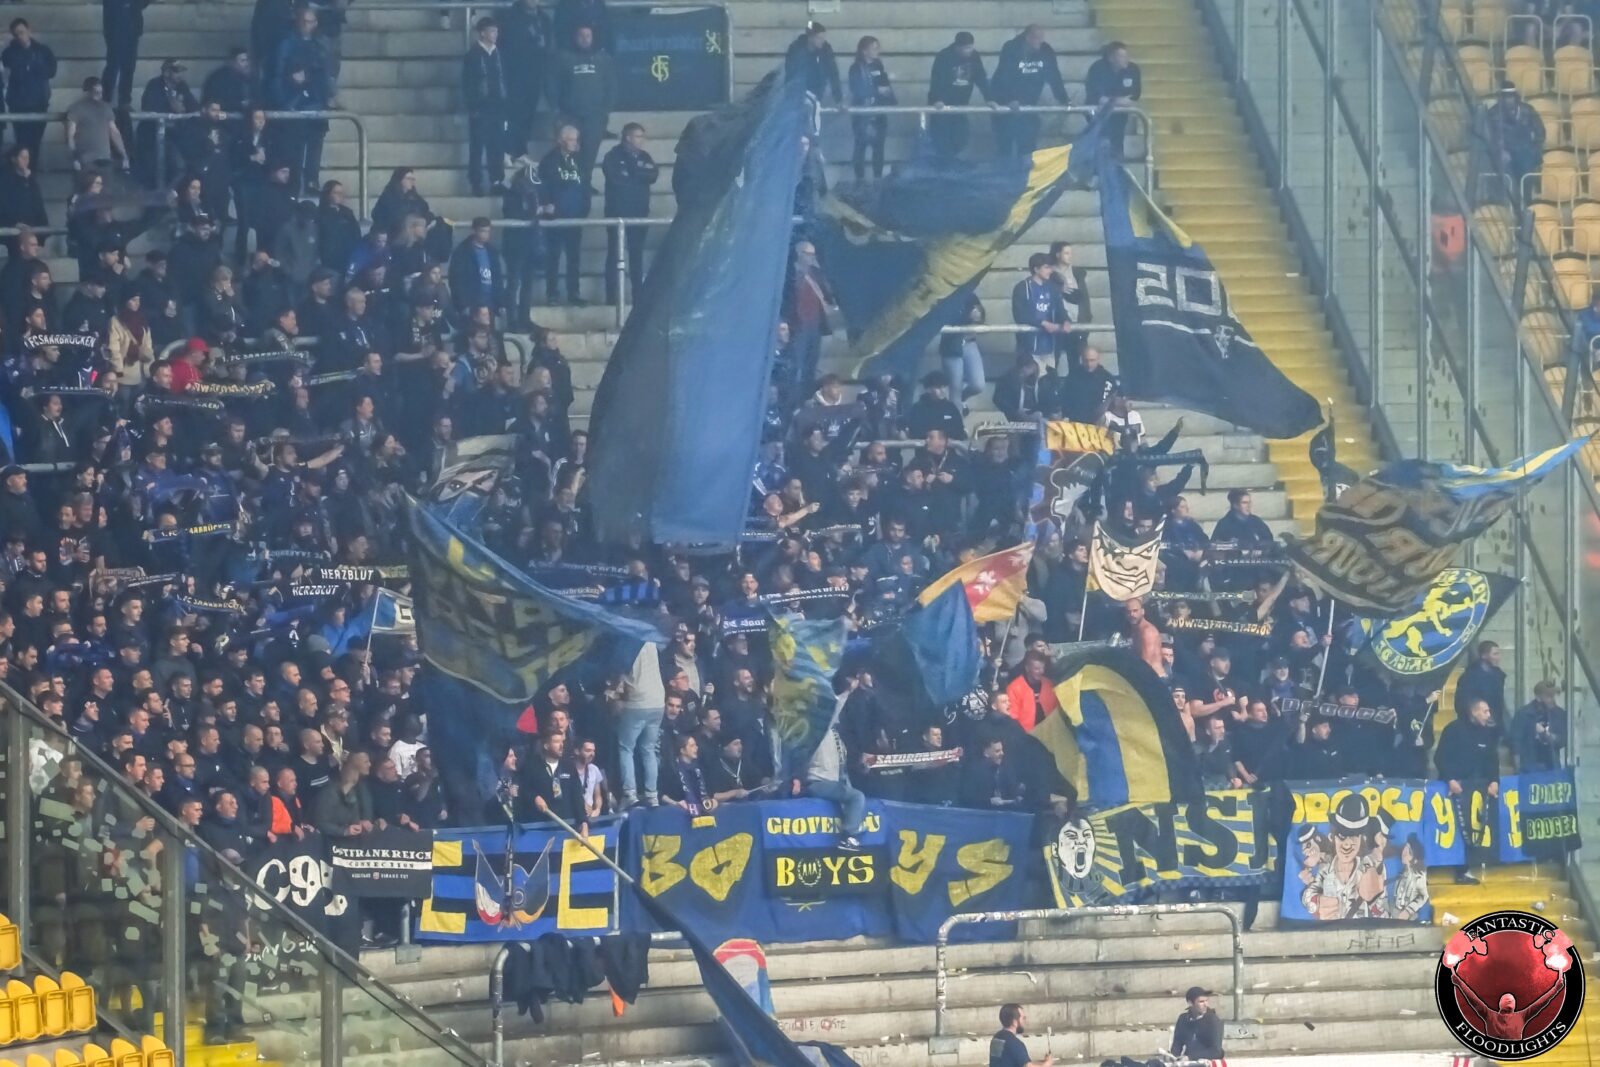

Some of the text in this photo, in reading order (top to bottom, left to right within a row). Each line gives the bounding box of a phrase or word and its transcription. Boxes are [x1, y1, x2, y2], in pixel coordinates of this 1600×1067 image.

[321, 568, 374, 581] HERZBLUT
[292, 584, 339, 596] HERZBLUT
[767, 811, 880, 835] GIOVEÙ
[348, 861, 414, 869] CONNECTION
